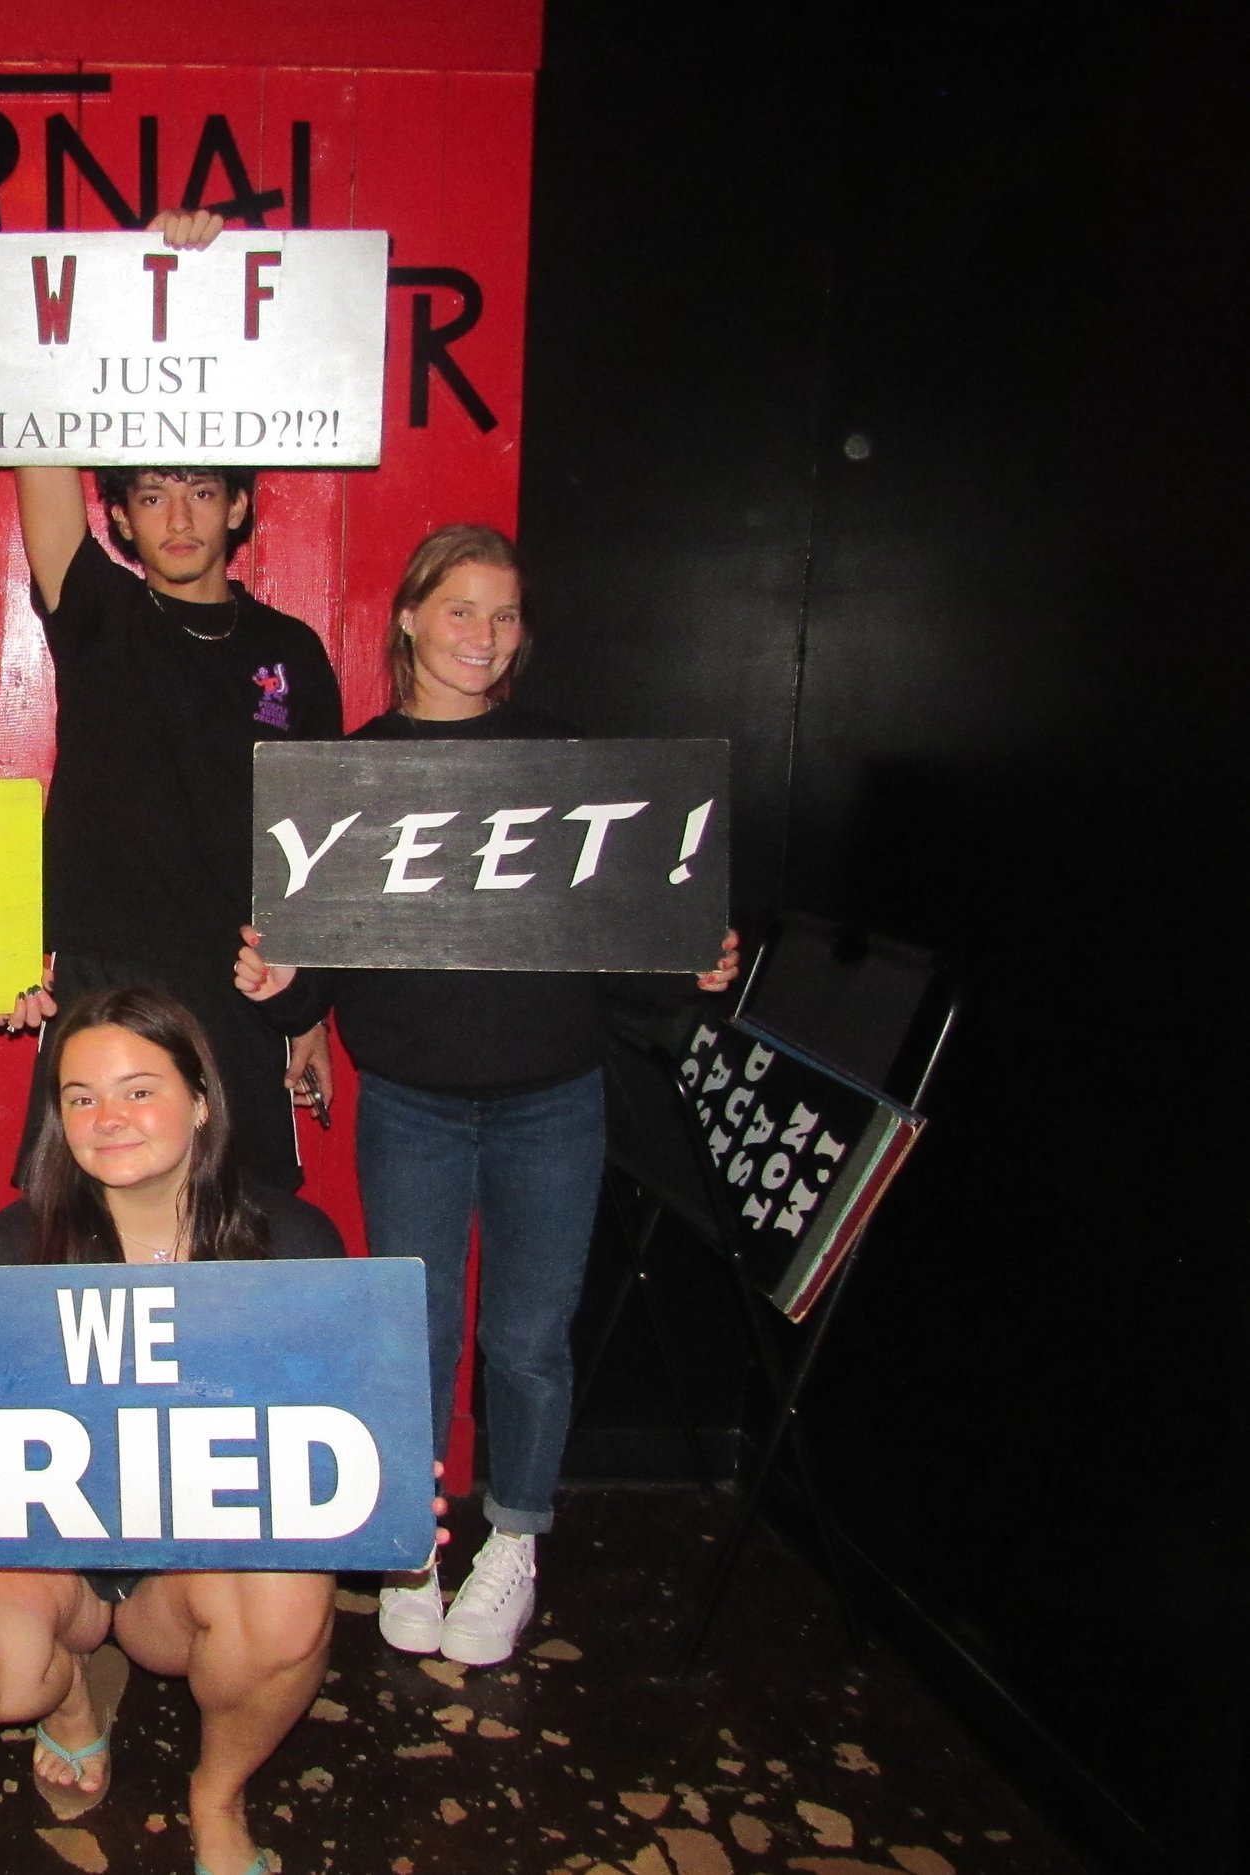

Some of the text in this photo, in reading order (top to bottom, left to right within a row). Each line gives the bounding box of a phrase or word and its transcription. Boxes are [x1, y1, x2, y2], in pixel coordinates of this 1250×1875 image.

[92, 355, 218, 395] JUST
[707, 1041, 775, 1168] DUM
[726, 1103, 776, 1187] AS
[741, 1101, 819, 1230] NOT
[773, 1130, 846, 1238] I'M
[57, 1286, 179, 1385] WE
